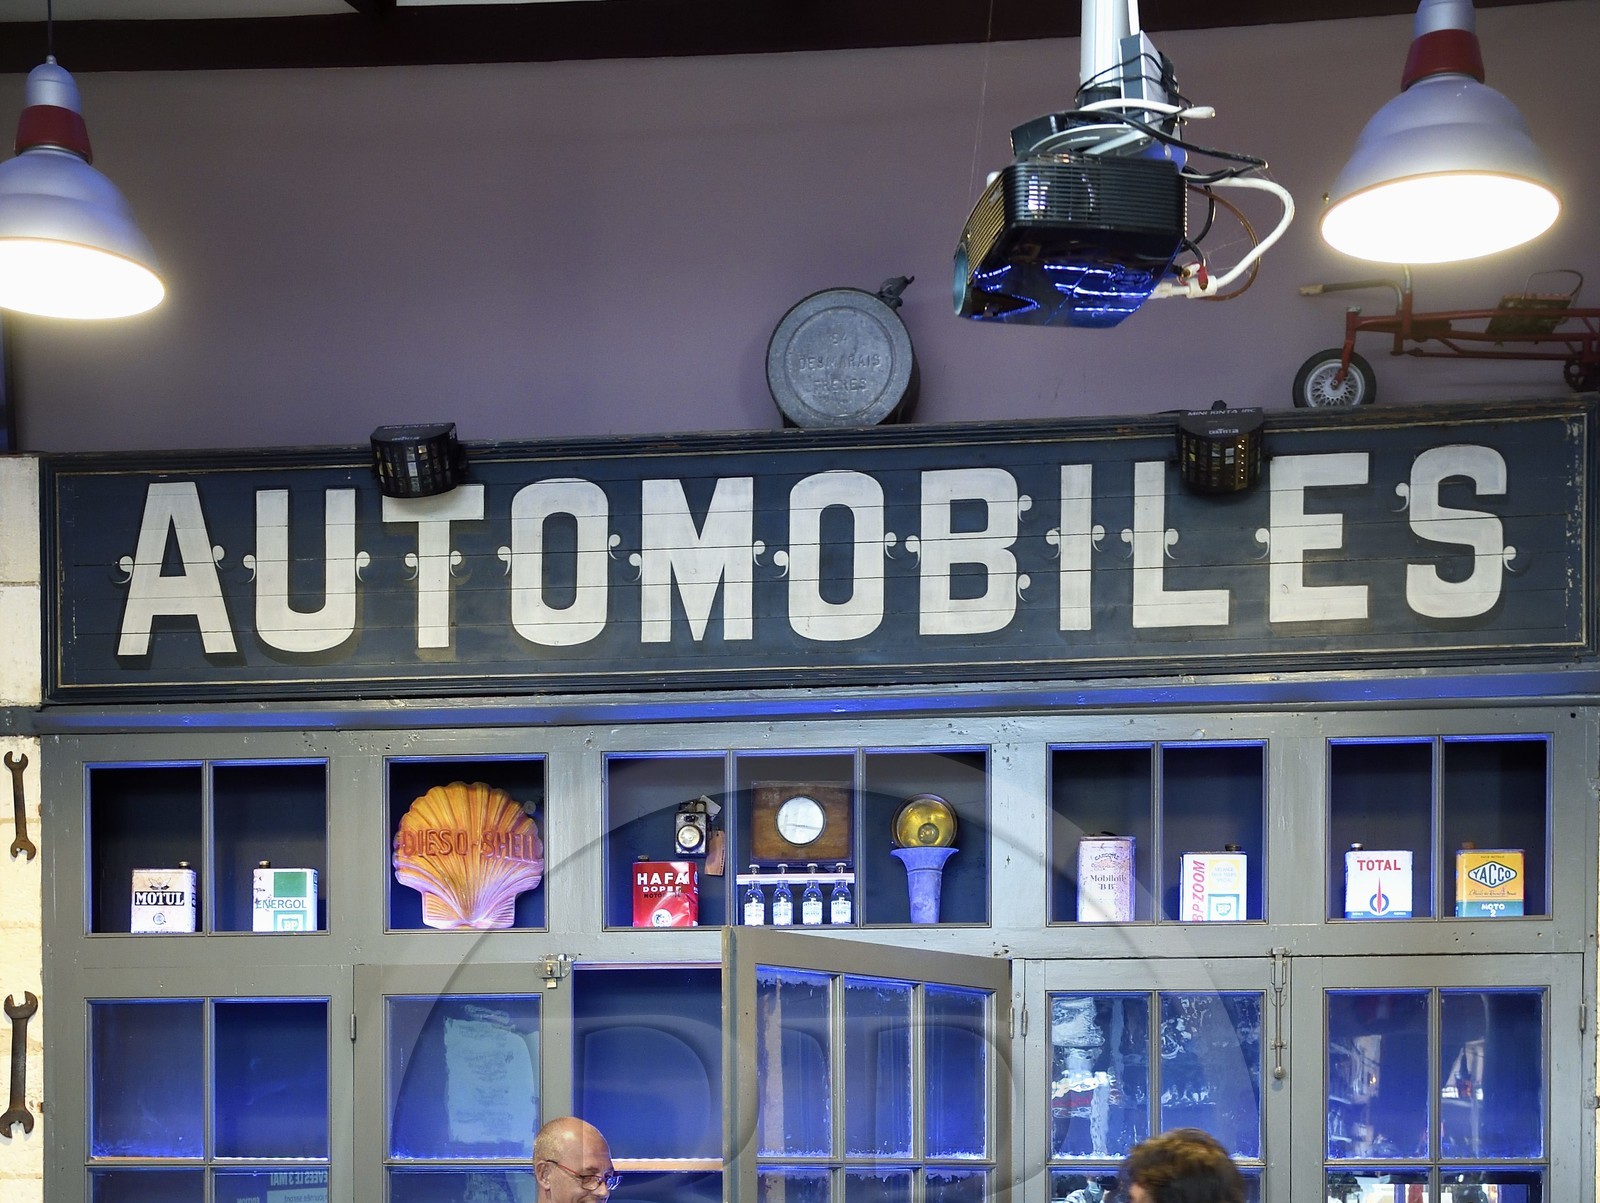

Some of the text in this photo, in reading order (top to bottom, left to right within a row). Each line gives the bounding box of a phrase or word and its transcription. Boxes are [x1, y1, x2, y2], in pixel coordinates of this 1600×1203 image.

[116, 445, 1508, 657] AUTOMOBILES
[1357, 859, 1401, 871] TOTAL
[637, 872, 690, 885] HAFA
[1473, 863, 1511, 885] YACCO
[135, 891, 184, 905] MOTUL
[256, 899, 307, 909] ENERGOL
[1481, 903, 1505, 911] MOTO
[1490, 909, 1497, 917] 2
[283, 919, 298, 931] BP
